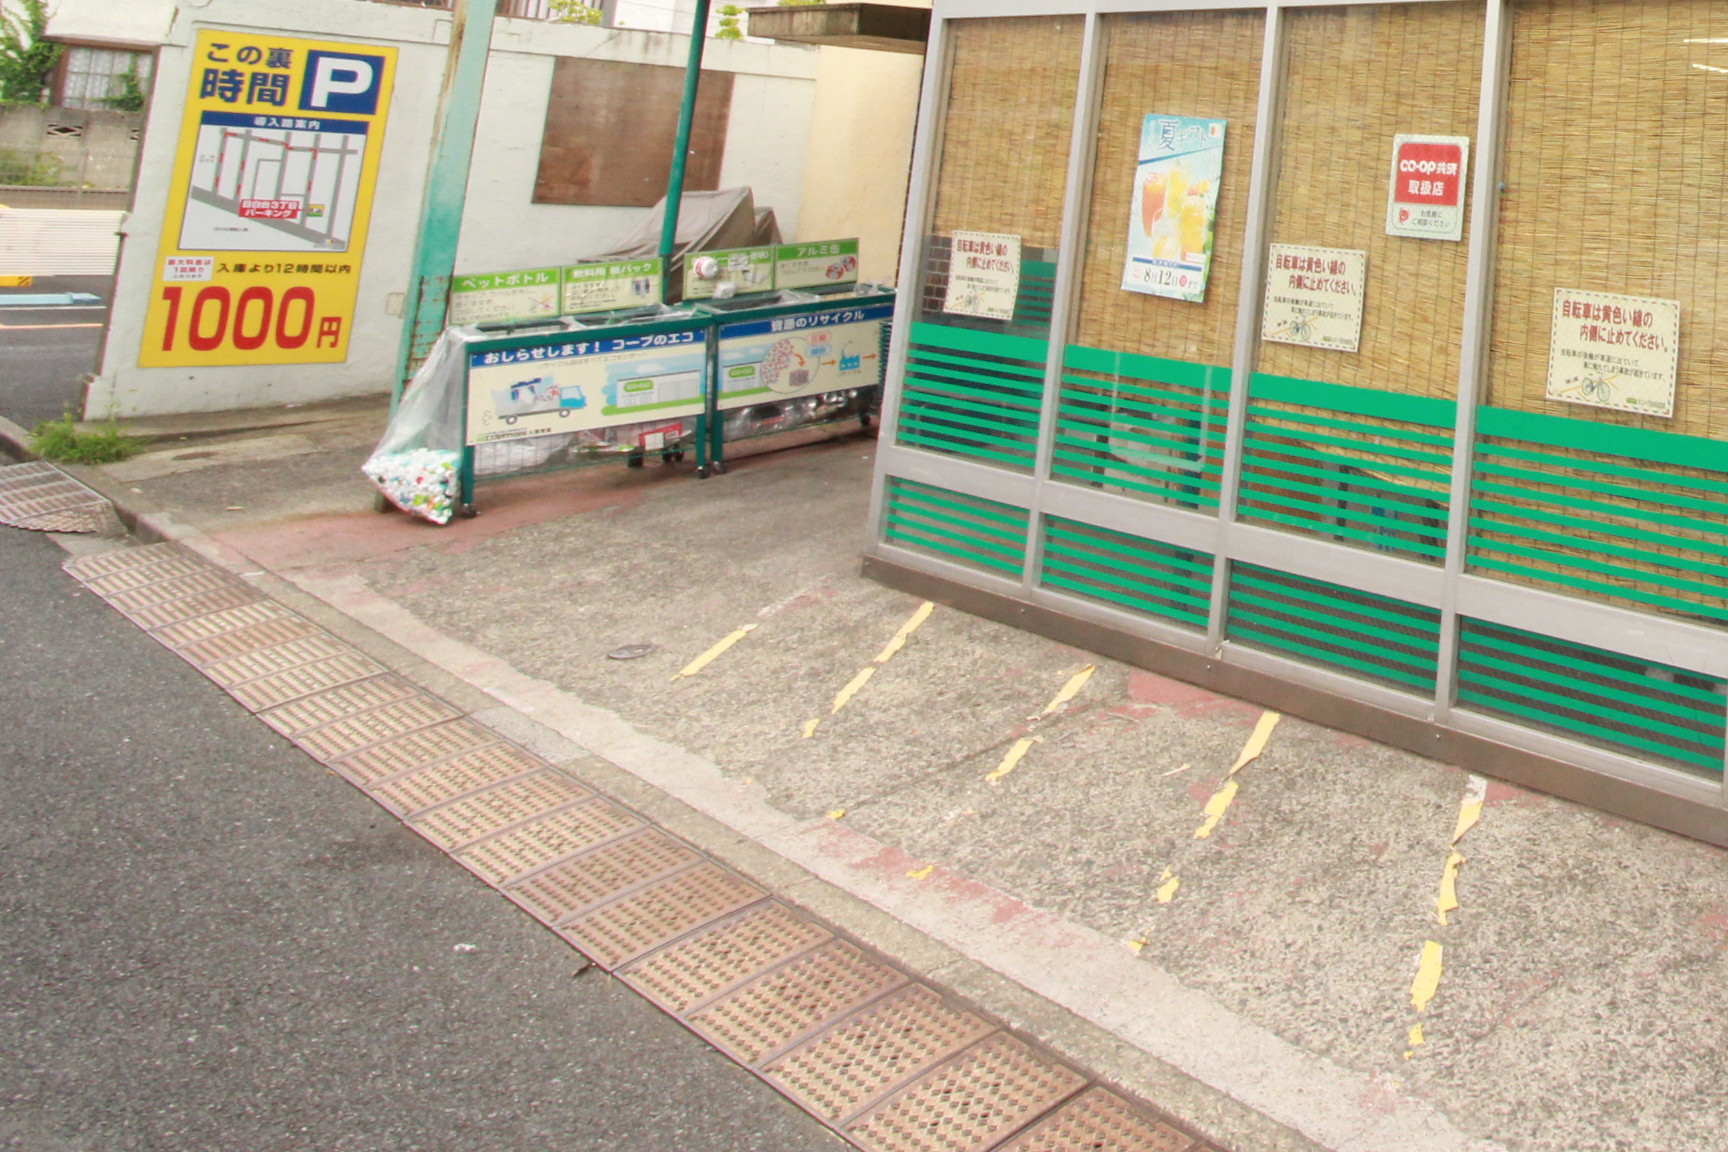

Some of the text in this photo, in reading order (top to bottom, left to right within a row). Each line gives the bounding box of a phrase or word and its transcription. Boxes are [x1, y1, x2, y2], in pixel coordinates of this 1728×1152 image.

[207, 43, 294, 70] この裏
[200, 68, 291, 107] 時間
[310, 57, 374, 108] P
[1408, 179, 1444, 196] 取扱店
[162, 286, 342, 351] 1000円
[1562, 300, 1653, 328] 自転車は黄色い線の
[1580, 324, 1668, 353] 内側に止めてください。
